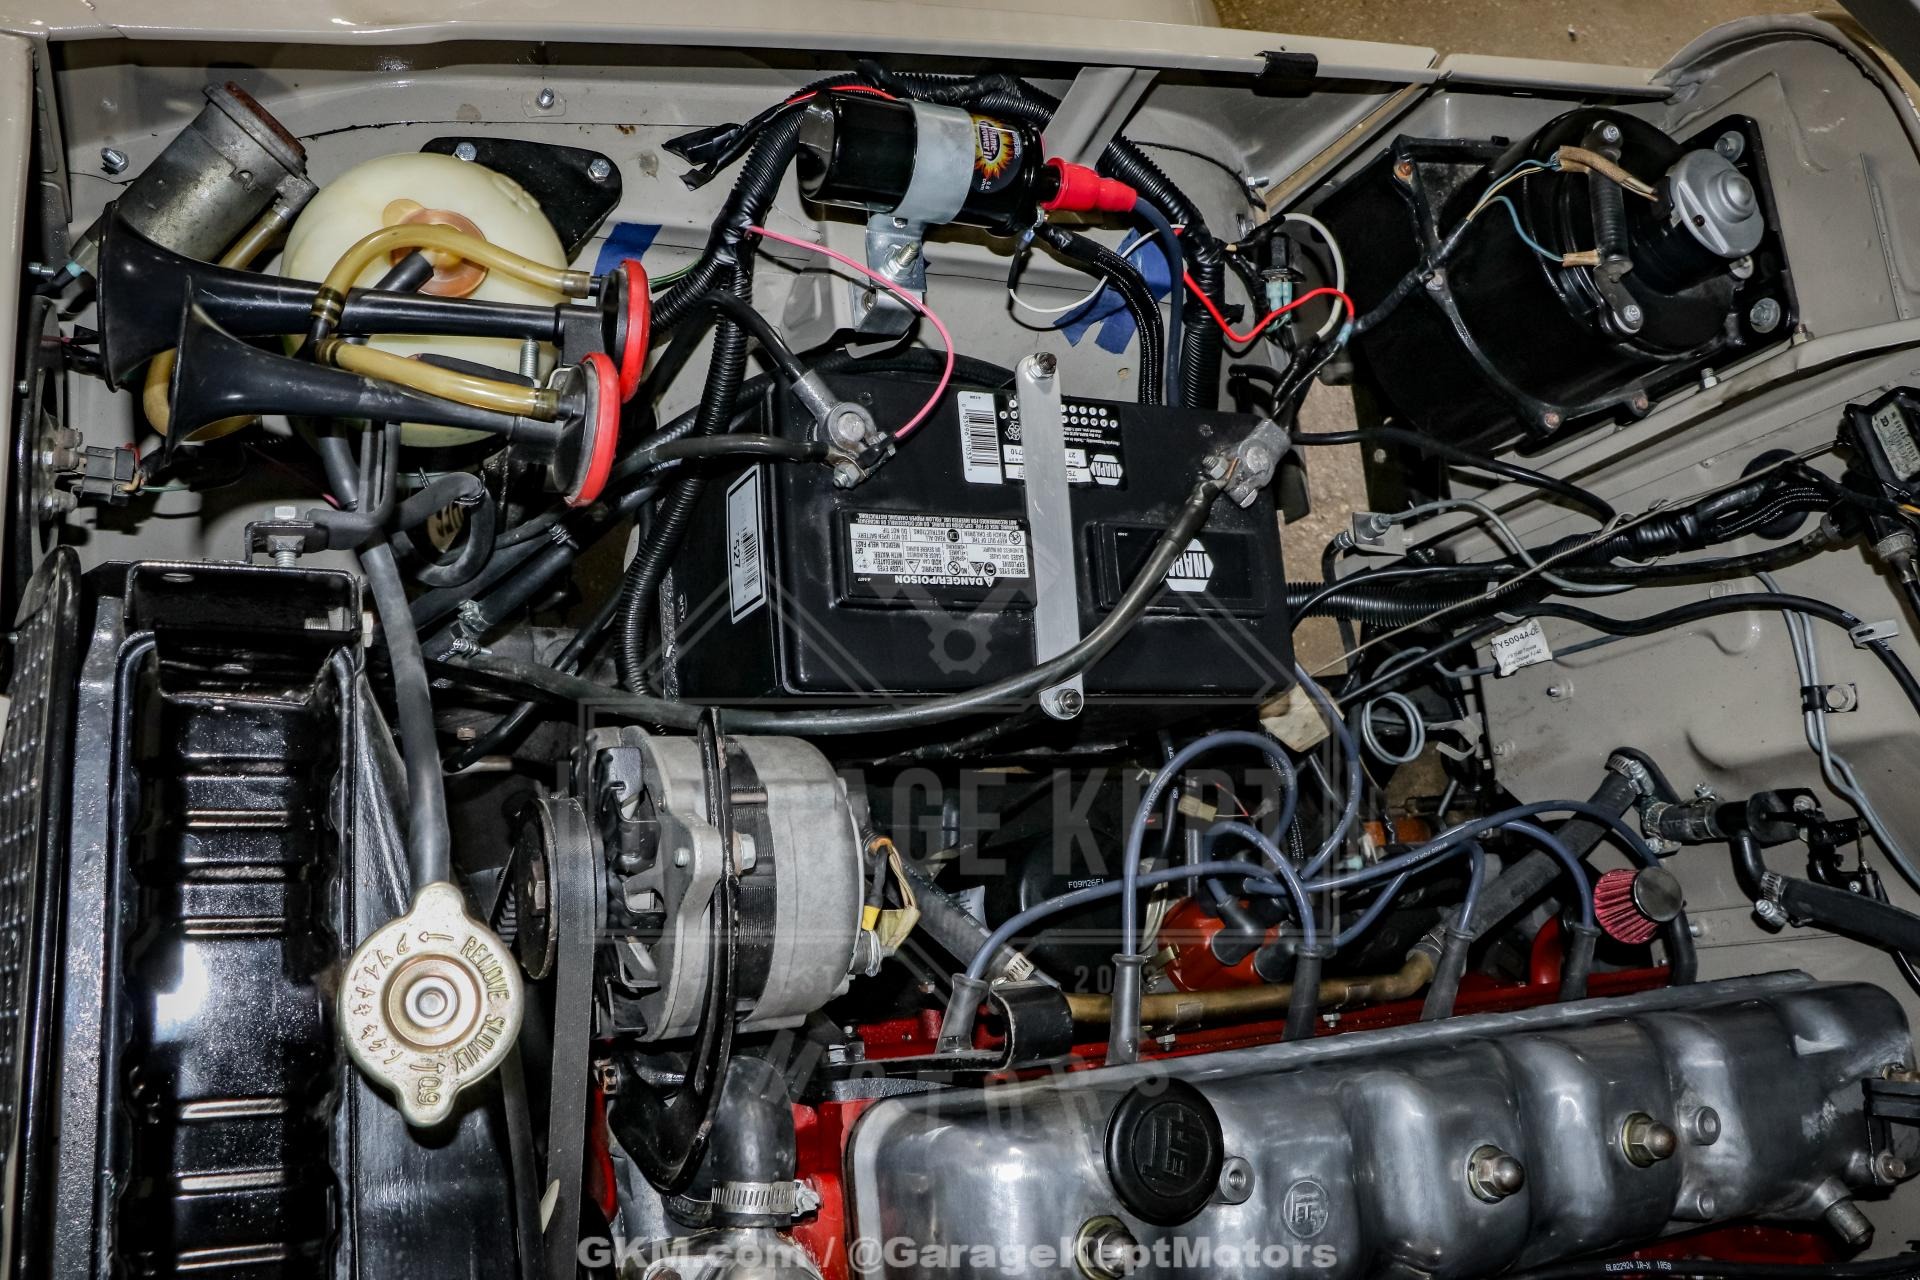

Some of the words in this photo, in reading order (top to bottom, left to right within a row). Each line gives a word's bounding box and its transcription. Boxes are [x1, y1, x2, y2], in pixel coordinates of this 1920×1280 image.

[1095, 462, 1117, 477] NAPA
[894, 575, 984, 586] DANGER/POISON
[460, 935, 509, 1004] REMOVE
[454, 1013, 505, 1075] SLOWLY
